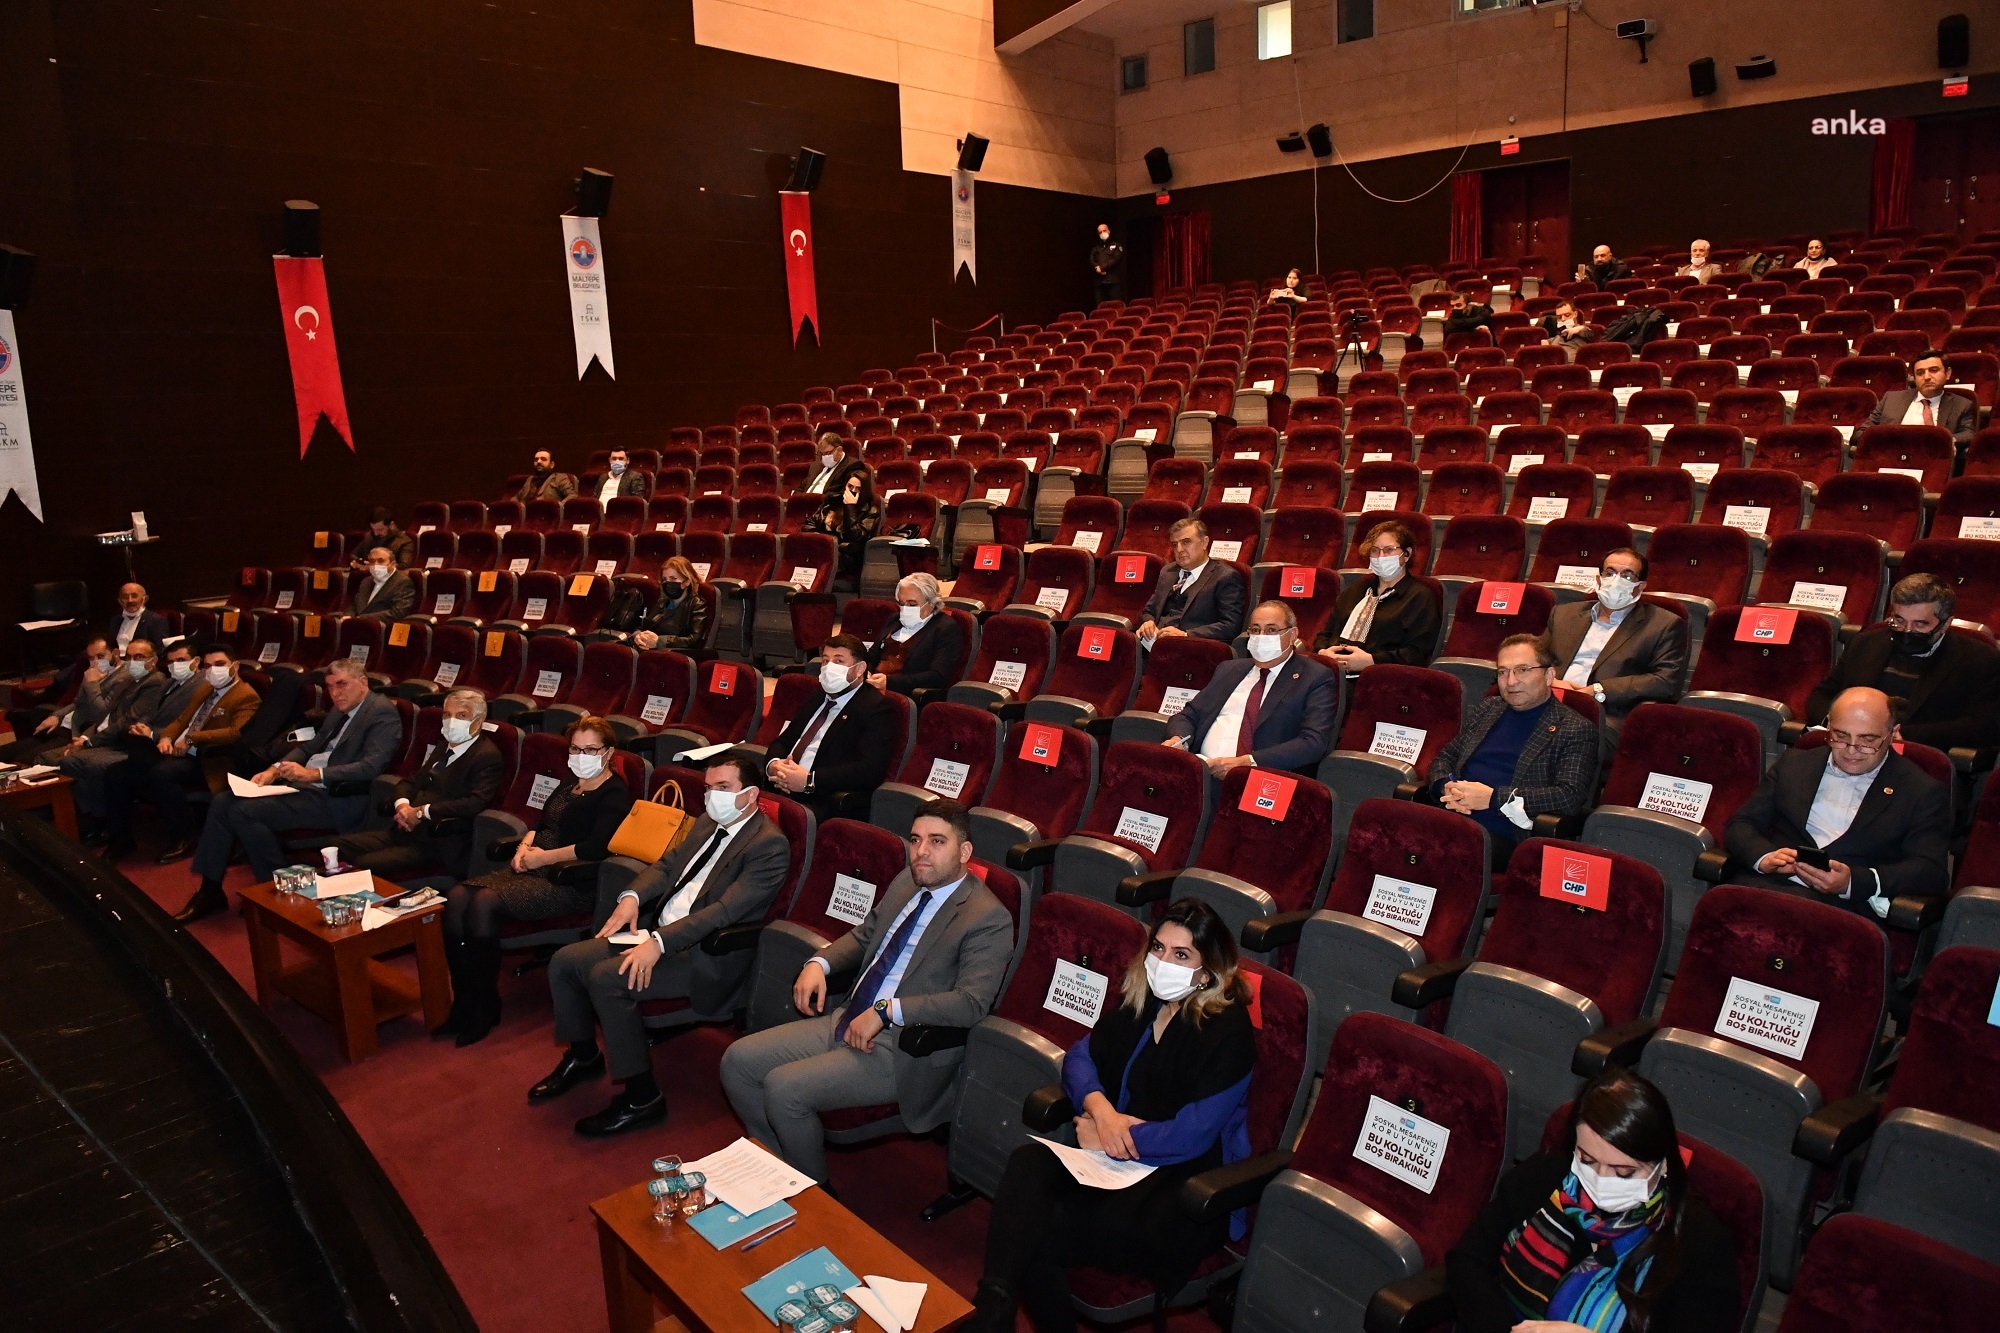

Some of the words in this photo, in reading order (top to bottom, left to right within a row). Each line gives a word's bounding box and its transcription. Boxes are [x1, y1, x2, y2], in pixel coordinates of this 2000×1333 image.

[1763, 648, 1769, 657] 9
[1379, 736, 1418, 747] KORUYUNUZ
[1386, 744, 1415, 754] KOLTUĞU
[1386, 751, 1412, 759] BIRAKINIZ
[1684, 756, 1690, 764] 7
[1149, 787, 1154, 795] 7
[1651, 790, 1701, 804] KORUYUNUZ
[1672, 789, 1703, 799] MESAFENİZİ
[1258, 799, 1272, 807] CHP
[1660, 799, 1700, 812] KOLTUĞU
[1661, 807, 1696, 818] BIRAKINIZ
[1410, 855, 1416, 864] 5
[1564, 882, 1584, 892] CHP
[1377, 894, 1425, 910] KORUYUNUZ
[1378, 889, 1396, 897] SOSYAL
[1398, 893, 1427, 904] MESAFENİZİ
[1373, 901, 1385, 909] BU
[1386, 904, 1422, 919] KOLTUĞU
[1371, 909, 1385, 917] BOŞ
[1386, 912, 1420, 926] BIRAKINIZ
[1774, 958, 1784, 969] 3
[1059, 974, 1074, 984] SOSYAL
[1058, 980, 1099, 999] KORUYUNUZ
[1054, 987, 1064, 996] BU
[1065, 991, 1097, 1010] KOLTUĞU
[1052, 996, 1064, 1006] BOŞ
[1065, 1000, 1094, 1018] BIRAKINIZ
[1733, 1001, 1803, 1027] KORUYUNUZ
[1735, 994, 1761, 1007] SOSYAL
[1763, 1002, 1806, 1020] MESAFENİZİ
[1729, 1010, 1744, 1021] BU
[1747, 1015, 1800, 1038] KOLTUĞU
[1726, 1019, 1746, 1032] BOŞ
[1748, 1025, 1797, 1047] BIRAKINIZ
[1408, 1099, 1416, 1111] 3
[1372, 1122, 1436, 1157] KORUYUNUZ
[1374, 1116, 1398, 1131] SOSYAL
[1399, 1126, 1439, 1149] MESAFENİZİ
[1368, 1132, 1381, 1147] BU
[1383, 1139, 1432, 1169] KOLTUĞU
[1365, 1143, 1383, 1157] BOŞ
[1384, 1150, 1429, 1179] BIRAKINIZ
